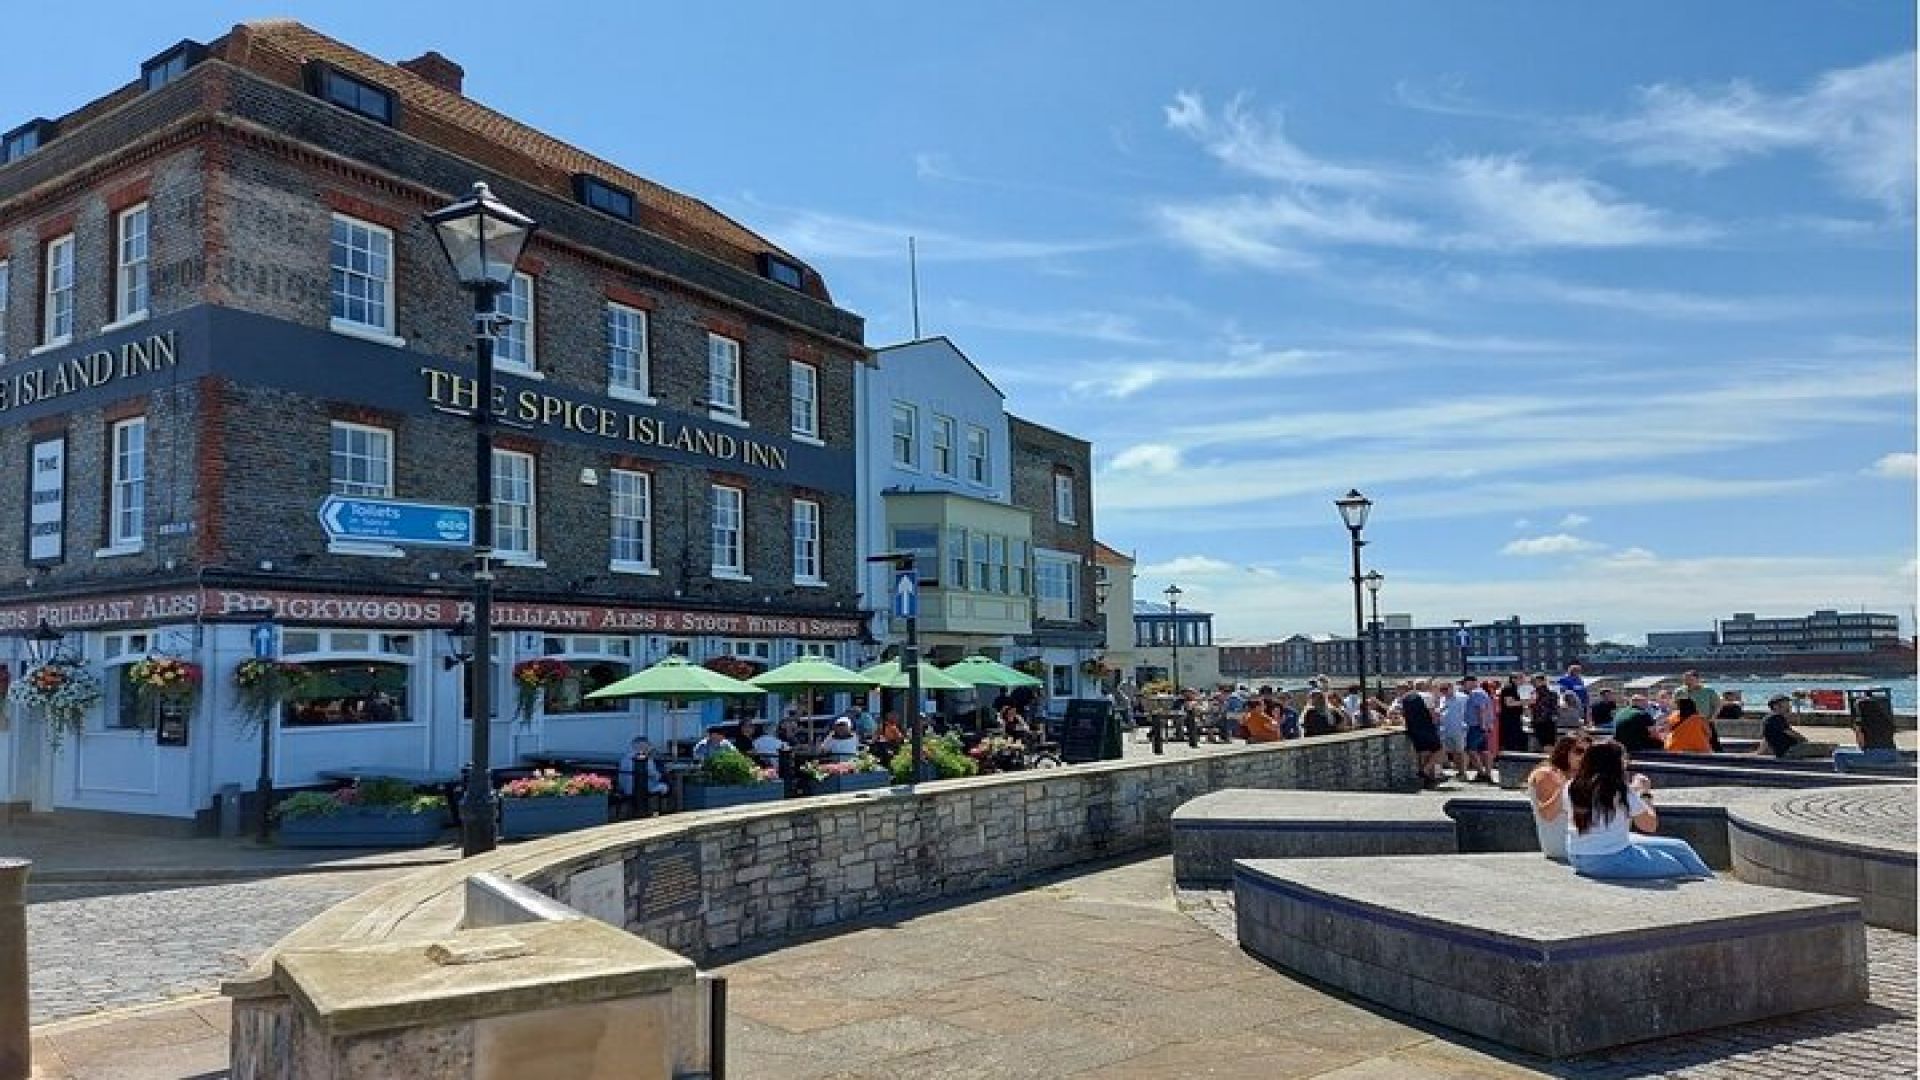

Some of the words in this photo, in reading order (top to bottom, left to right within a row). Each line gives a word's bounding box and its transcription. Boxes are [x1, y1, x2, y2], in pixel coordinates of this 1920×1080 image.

[13, 350, 113, 407] ISLAND
[121, 329, 176, 378] INN
[420, 367, 508, 416] THE
[519, 390, 619, 438] SPICE
[626, 414, 737, 459] ISLAND
[742, 439, 788, 470] INN
[350, 503, 401, 520] Toilets
[663, 614, 676, 630] &
